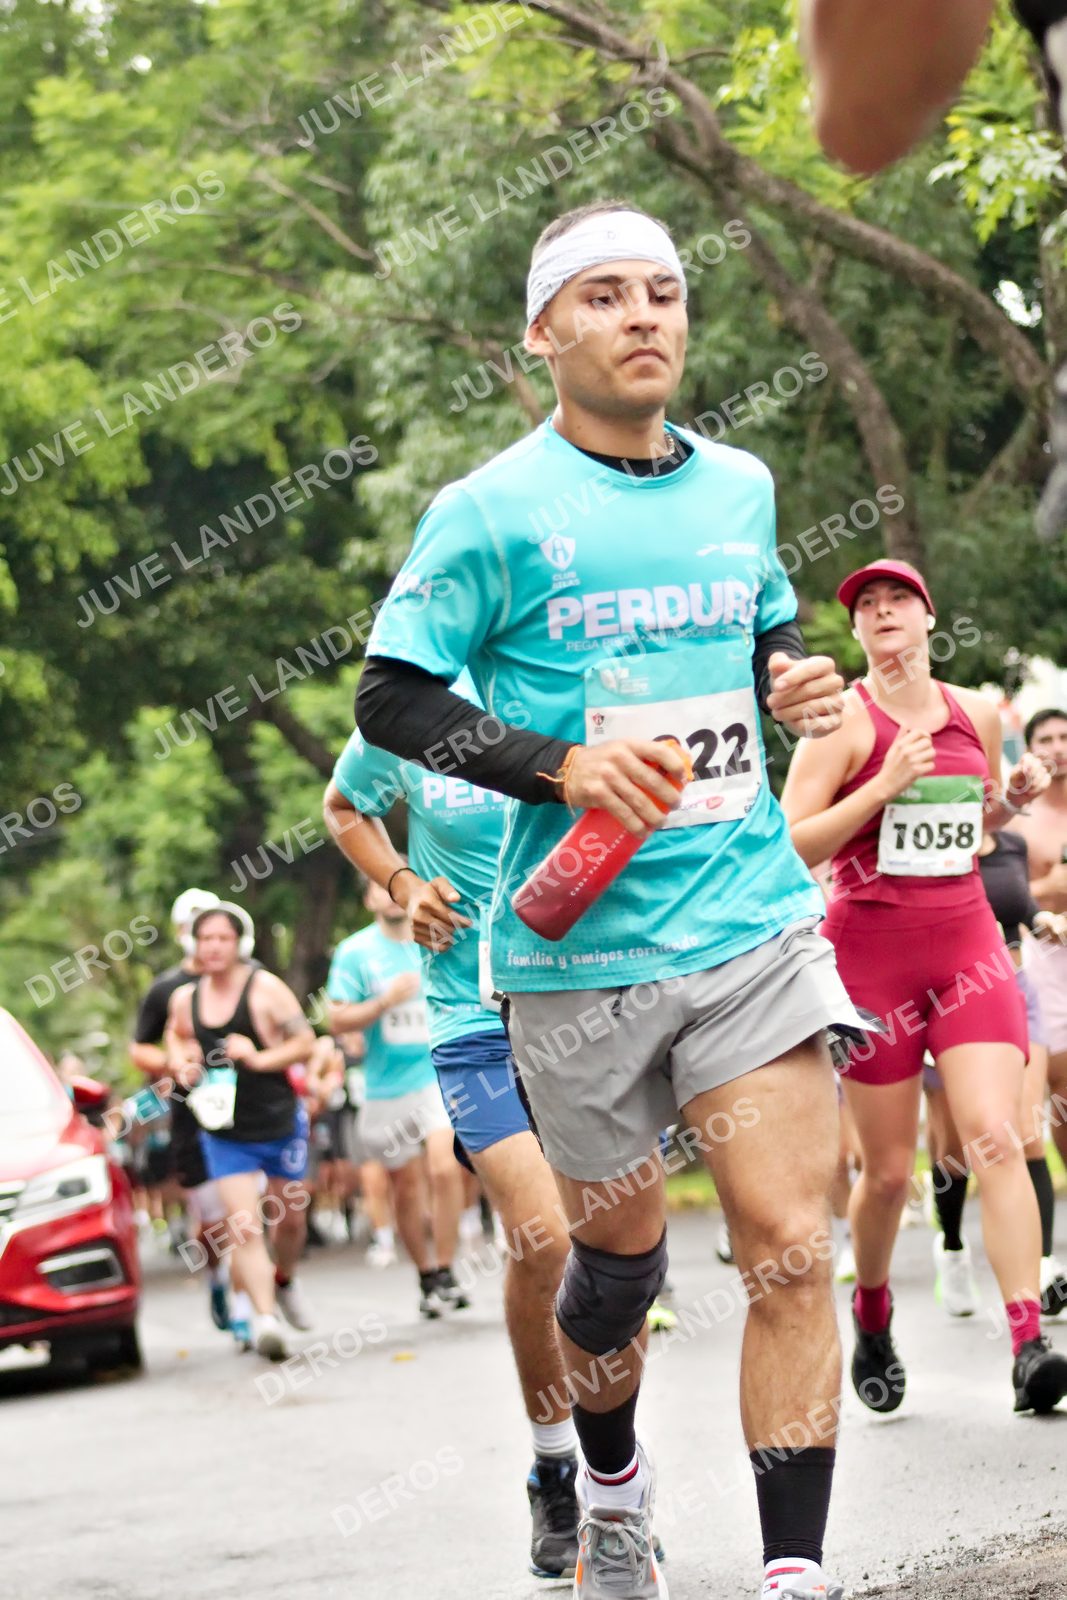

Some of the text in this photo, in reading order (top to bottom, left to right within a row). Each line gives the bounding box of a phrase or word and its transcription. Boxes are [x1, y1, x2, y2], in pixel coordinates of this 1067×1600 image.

[566, 637, 600, 652] PEGA
[652, 722, 752, 781] 22
[893, 822, 975, 850] 1058
[507, 934, 700, 969] familia y amigos corriendo
